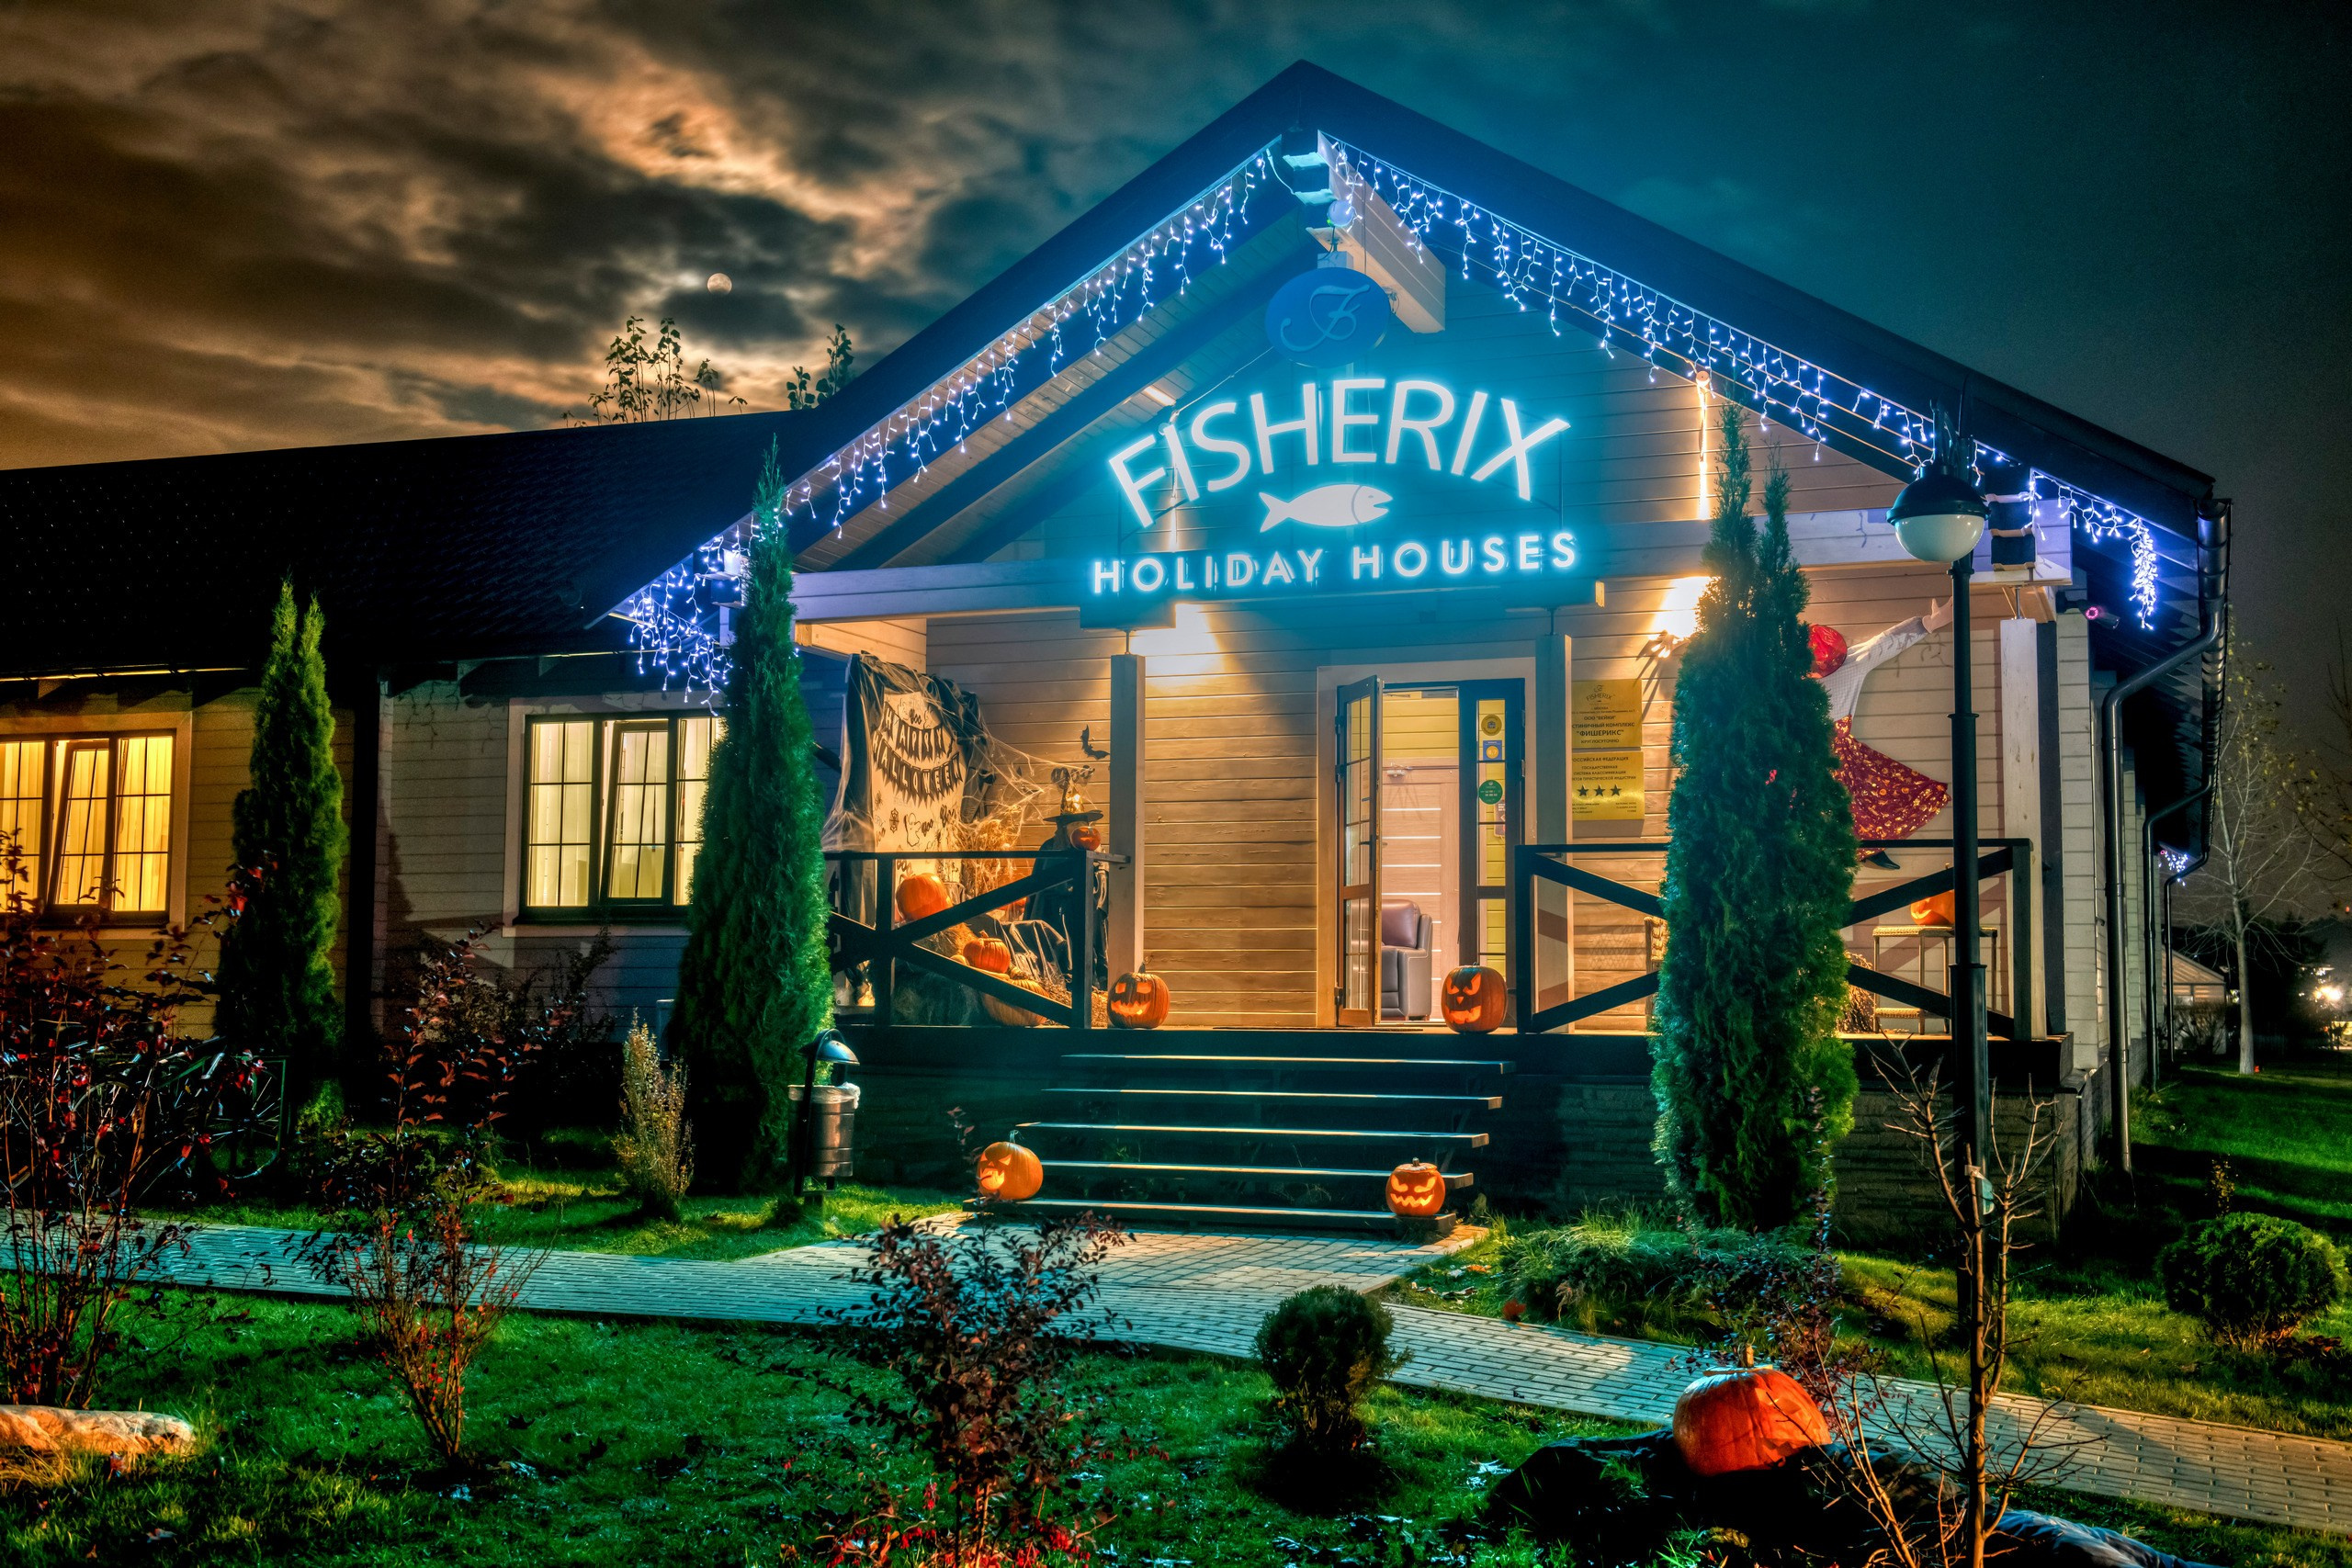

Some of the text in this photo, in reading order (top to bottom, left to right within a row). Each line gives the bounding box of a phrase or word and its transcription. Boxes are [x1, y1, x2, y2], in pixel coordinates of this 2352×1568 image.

[1107, 378, 1572, 529] FISHERIX
[1092, 532, 1577, 594] HOLIDAY HOUSES
[884, 706, 944, 750] HAPPY
[872, 732, 960, 795] HALLOWEEN
